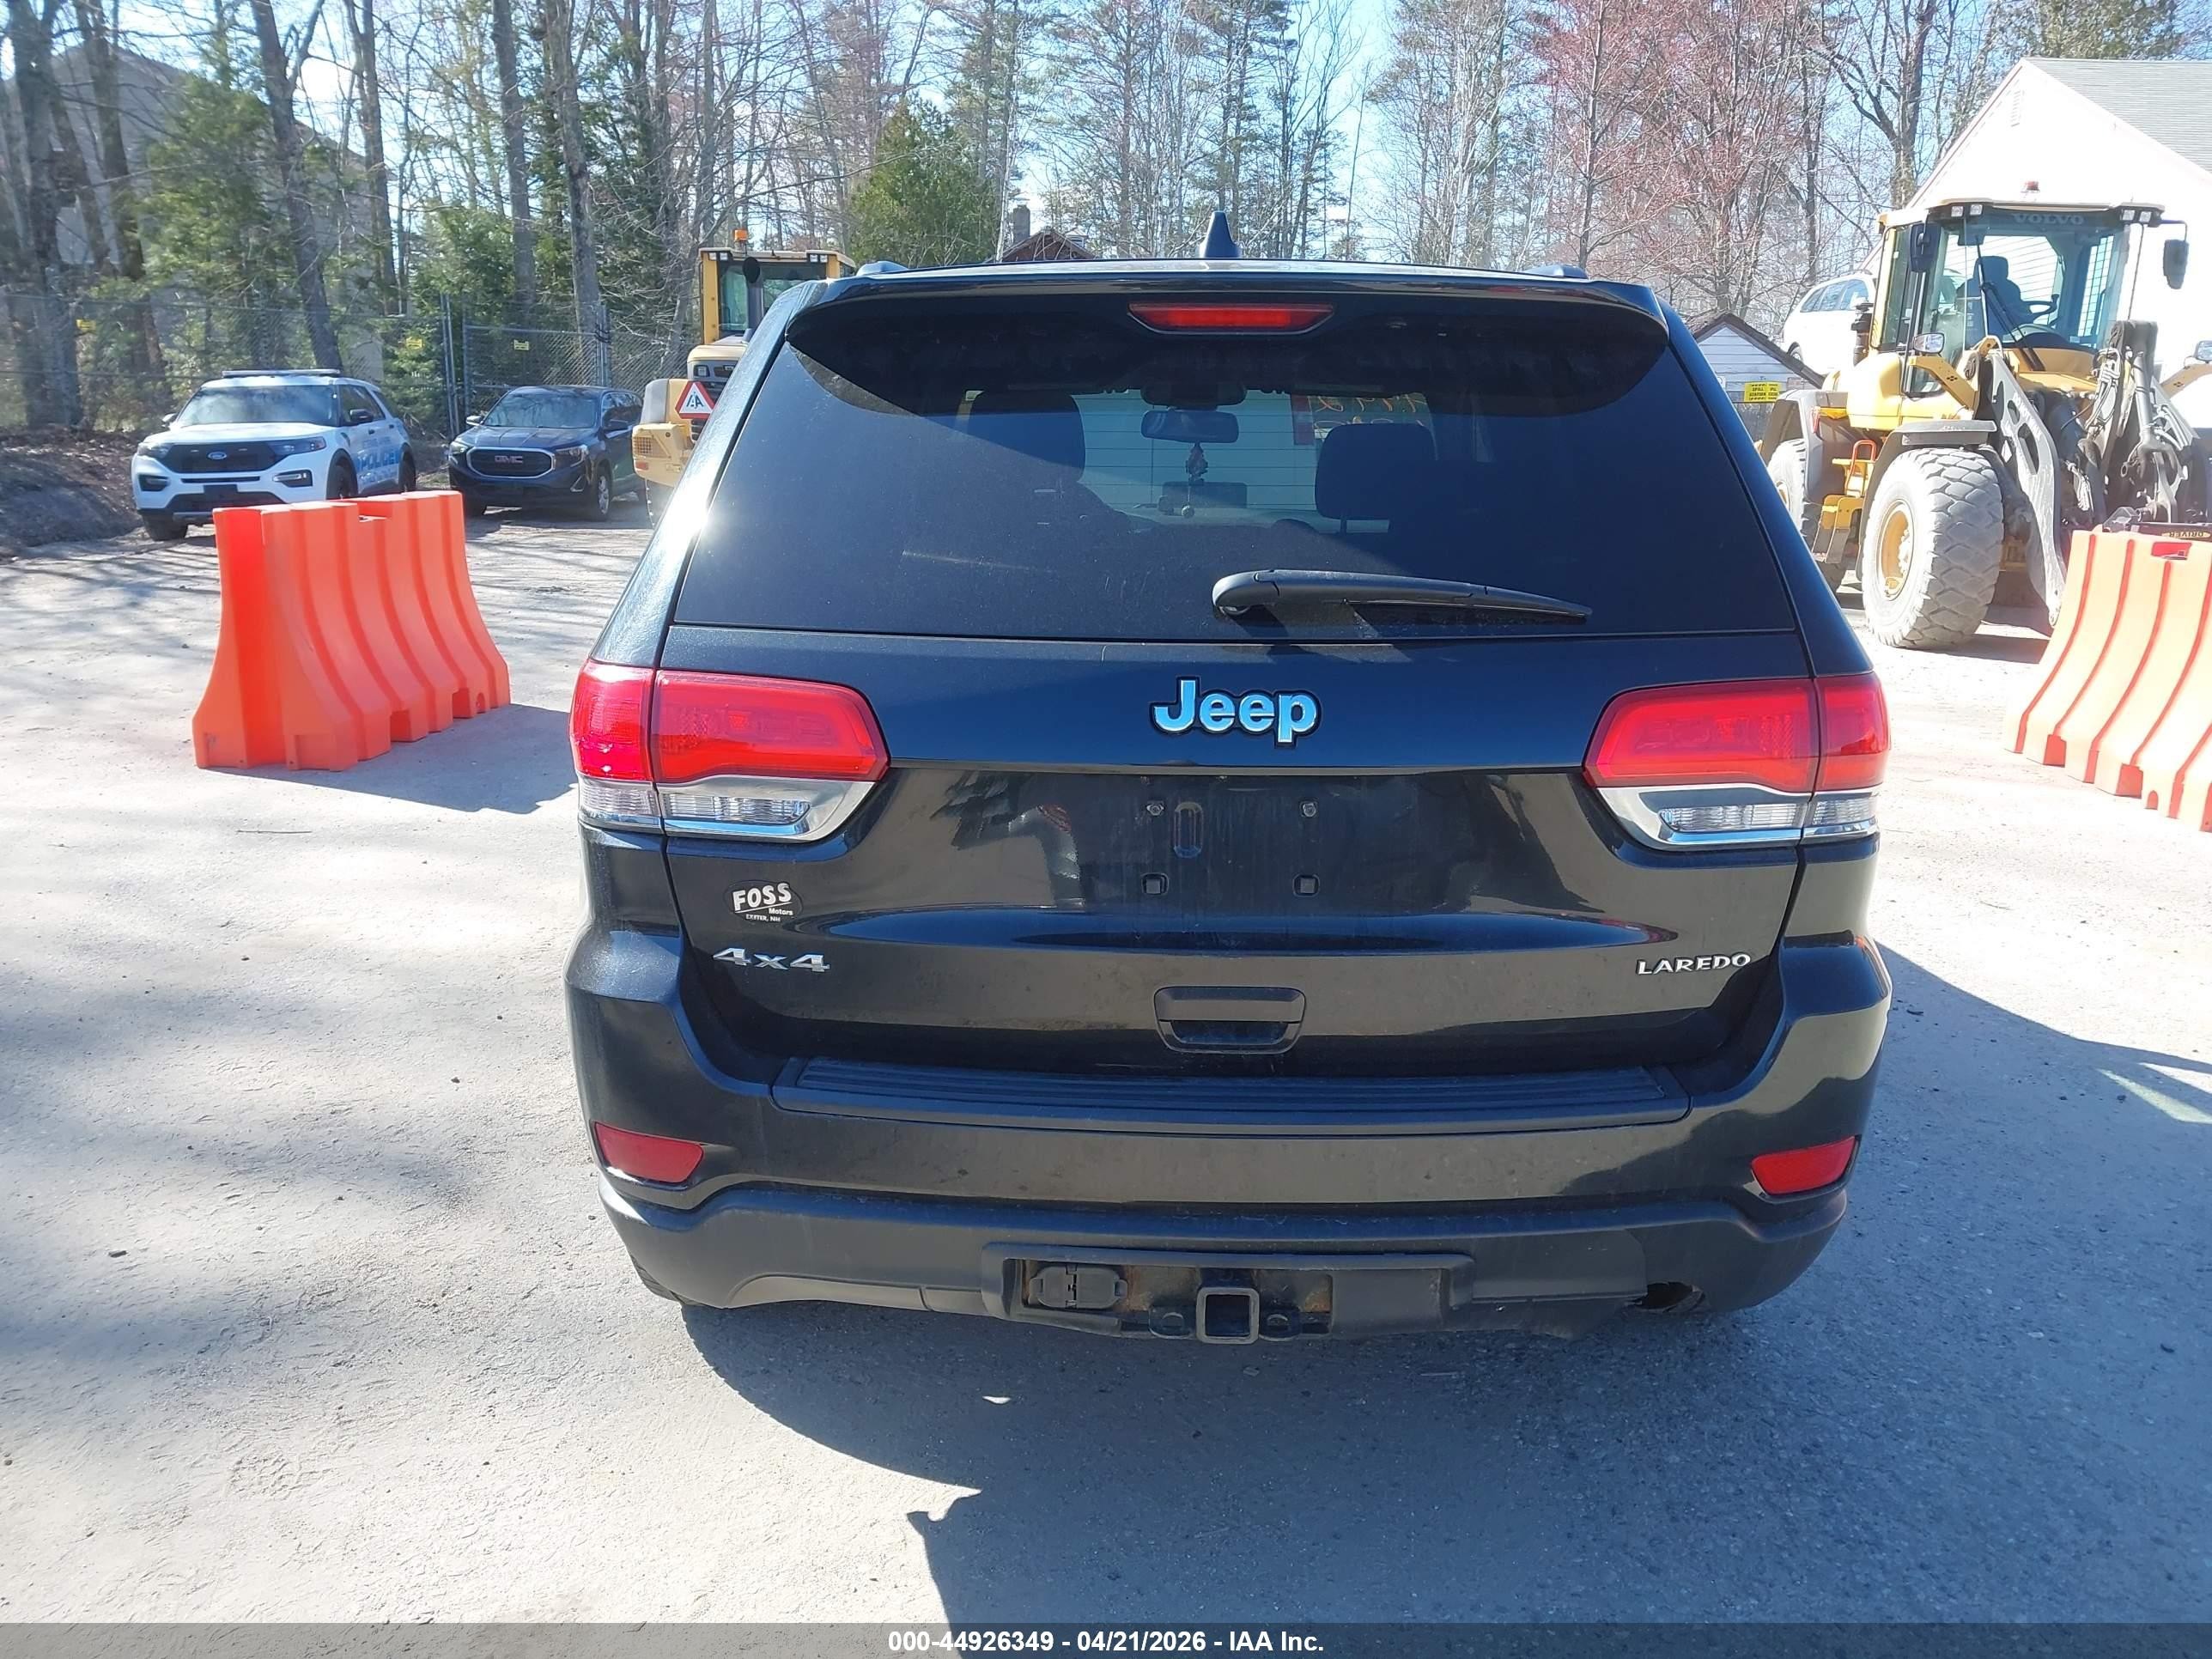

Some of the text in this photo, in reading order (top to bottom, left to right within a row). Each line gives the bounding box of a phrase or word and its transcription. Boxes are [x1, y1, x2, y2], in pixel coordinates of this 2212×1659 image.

[2011, 213, 2084, 225] VOLVO
[1153, 679, 1317, 743] Jeep
[732, 883, 792, 911] FOSS
[769, 908, 793, 916] Motors
[713, 947, 830, 973] 4x4
[1638, 953, 1752, 975] LAREDO
